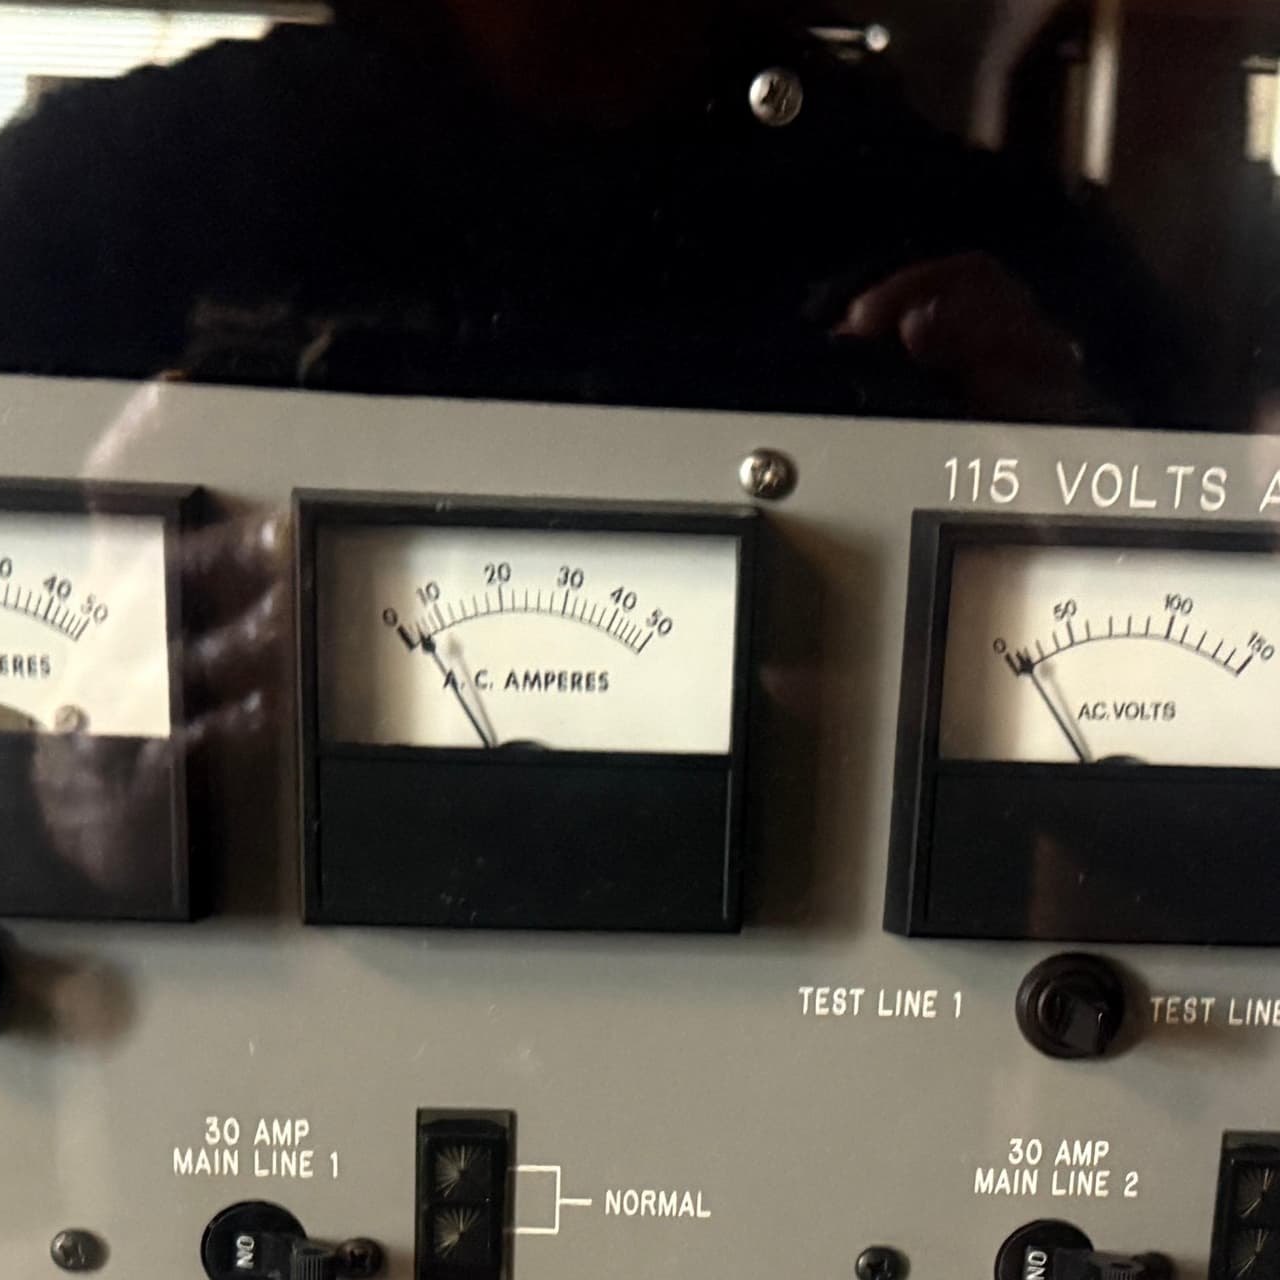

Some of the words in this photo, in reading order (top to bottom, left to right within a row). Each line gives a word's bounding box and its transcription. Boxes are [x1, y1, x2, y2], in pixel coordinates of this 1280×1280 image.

[944, 458, 1019, 503] 115
[1056, 461, 1228, 512] VOLTS
[43, 573, 72, 600] 40
[484, 562, 511, 584] 20
[558, 566, 584, 589] 30
[416, 581, 441, 606] 10
[609, 586, 637, 612] 40
[1164, 594, 1193, 616] 100
[79, 594, 108, 624] 50
[382, 607, 399, 627] 0
[645, 609, 673, 636] 50
[1053, 599, 1078, 622] 50
[993, 638, 1006, 655] 0
[1246, 630, 1276, 662] 150
[443, 670, 465, 689] A.
[475, 670, 494, 690] C.
[504, 671, 609, 692] AMPERES
[1114, 702, 1176, 721] VOLTS
[799, 987, 866, 1016] TEST
[878, 990, 938, 1018] LINE
[953, 992, 963, 1019] 1
[1151, 997, 1216, 1024] TEST
[205, 1117, 240, 1146] 30
[254, 1120, 310, 1146] AMP
[172, 1148, 239, 1176] MAIN
[254, 1150, 314, 1178] LINE
[330, 1152, 340, 1178] 1
[1008, 1139, 1043, 1166] 30
[1055, 1140, 1110, 1166] AMP
[974, 1169, 1039, 1195] MAIN
[1050, 1171, 1109, 1197] LINE
[1124, 1172, 1139, 1198] 2
[604, 1190, 712, 1218] NORMAL
[236, 1234, 254, 1269] ON
